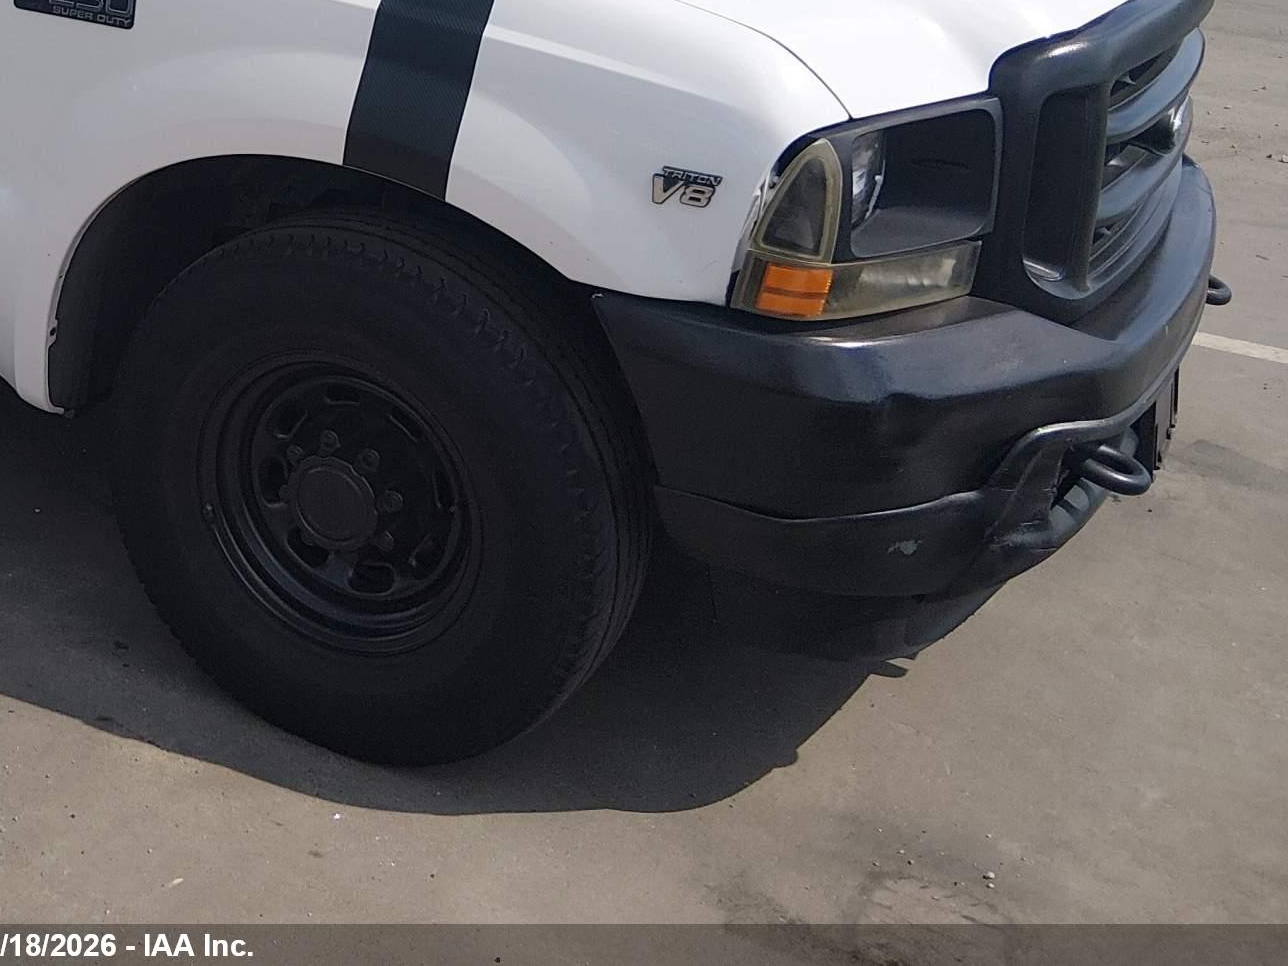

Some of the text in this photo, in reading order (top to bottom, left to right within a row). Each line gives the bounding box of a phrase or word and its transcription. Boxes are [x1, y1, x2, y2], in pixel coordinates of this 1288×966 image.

[52, 4, 132, 27] SUPER DUTY
[662, 168, 721, 186] TRITON
[652, 173, 715, 208] V8
